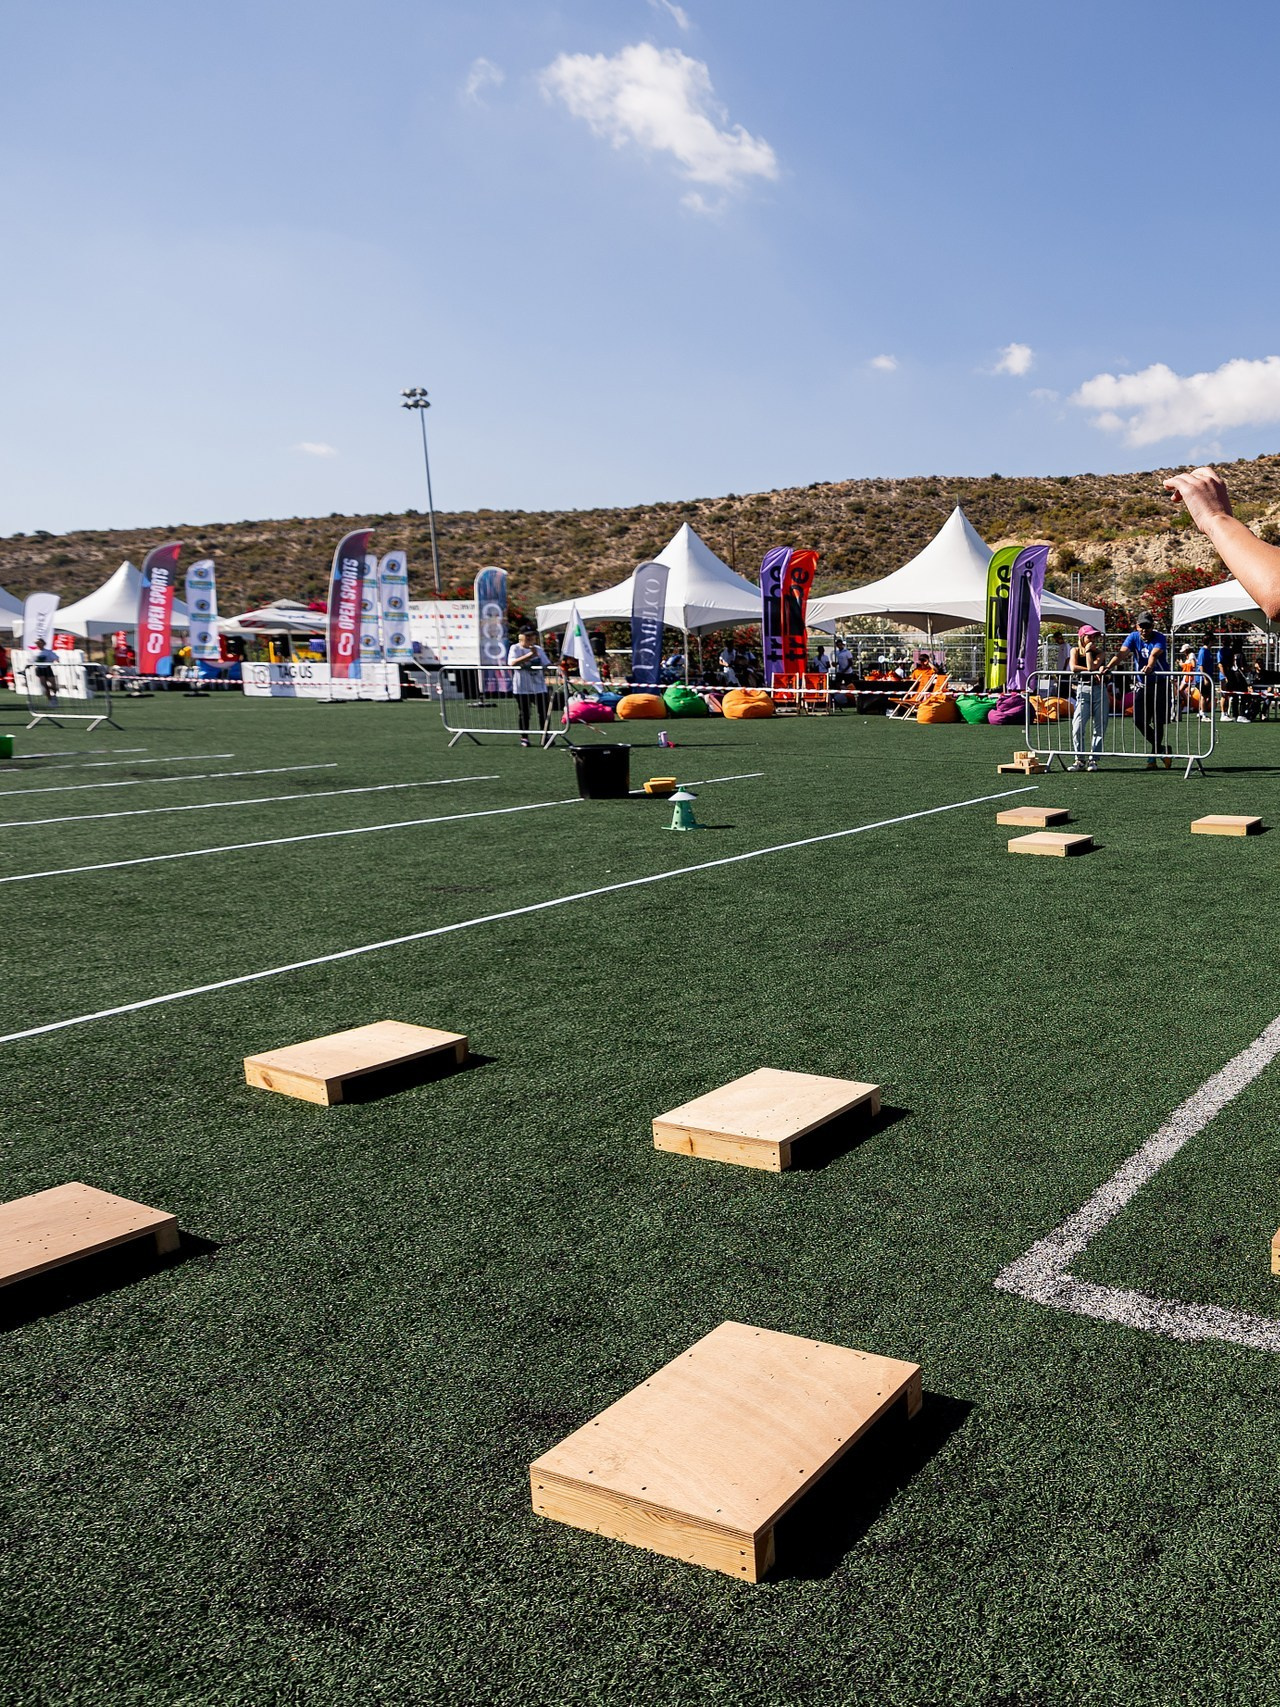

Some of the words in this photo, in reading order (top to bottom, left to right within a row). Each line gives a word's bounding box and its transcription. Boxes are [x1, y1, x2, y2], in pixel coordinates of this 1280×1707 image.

[149, 567, 169, 604] SPORTS
[341, 558, 359, 600] SPORTS
[147, 605, 165, 631] OPEN
[338, 602, 356, 630] OPEN
[277, 665, 297, 678] TAG
[300, 665, 313, 678] US
